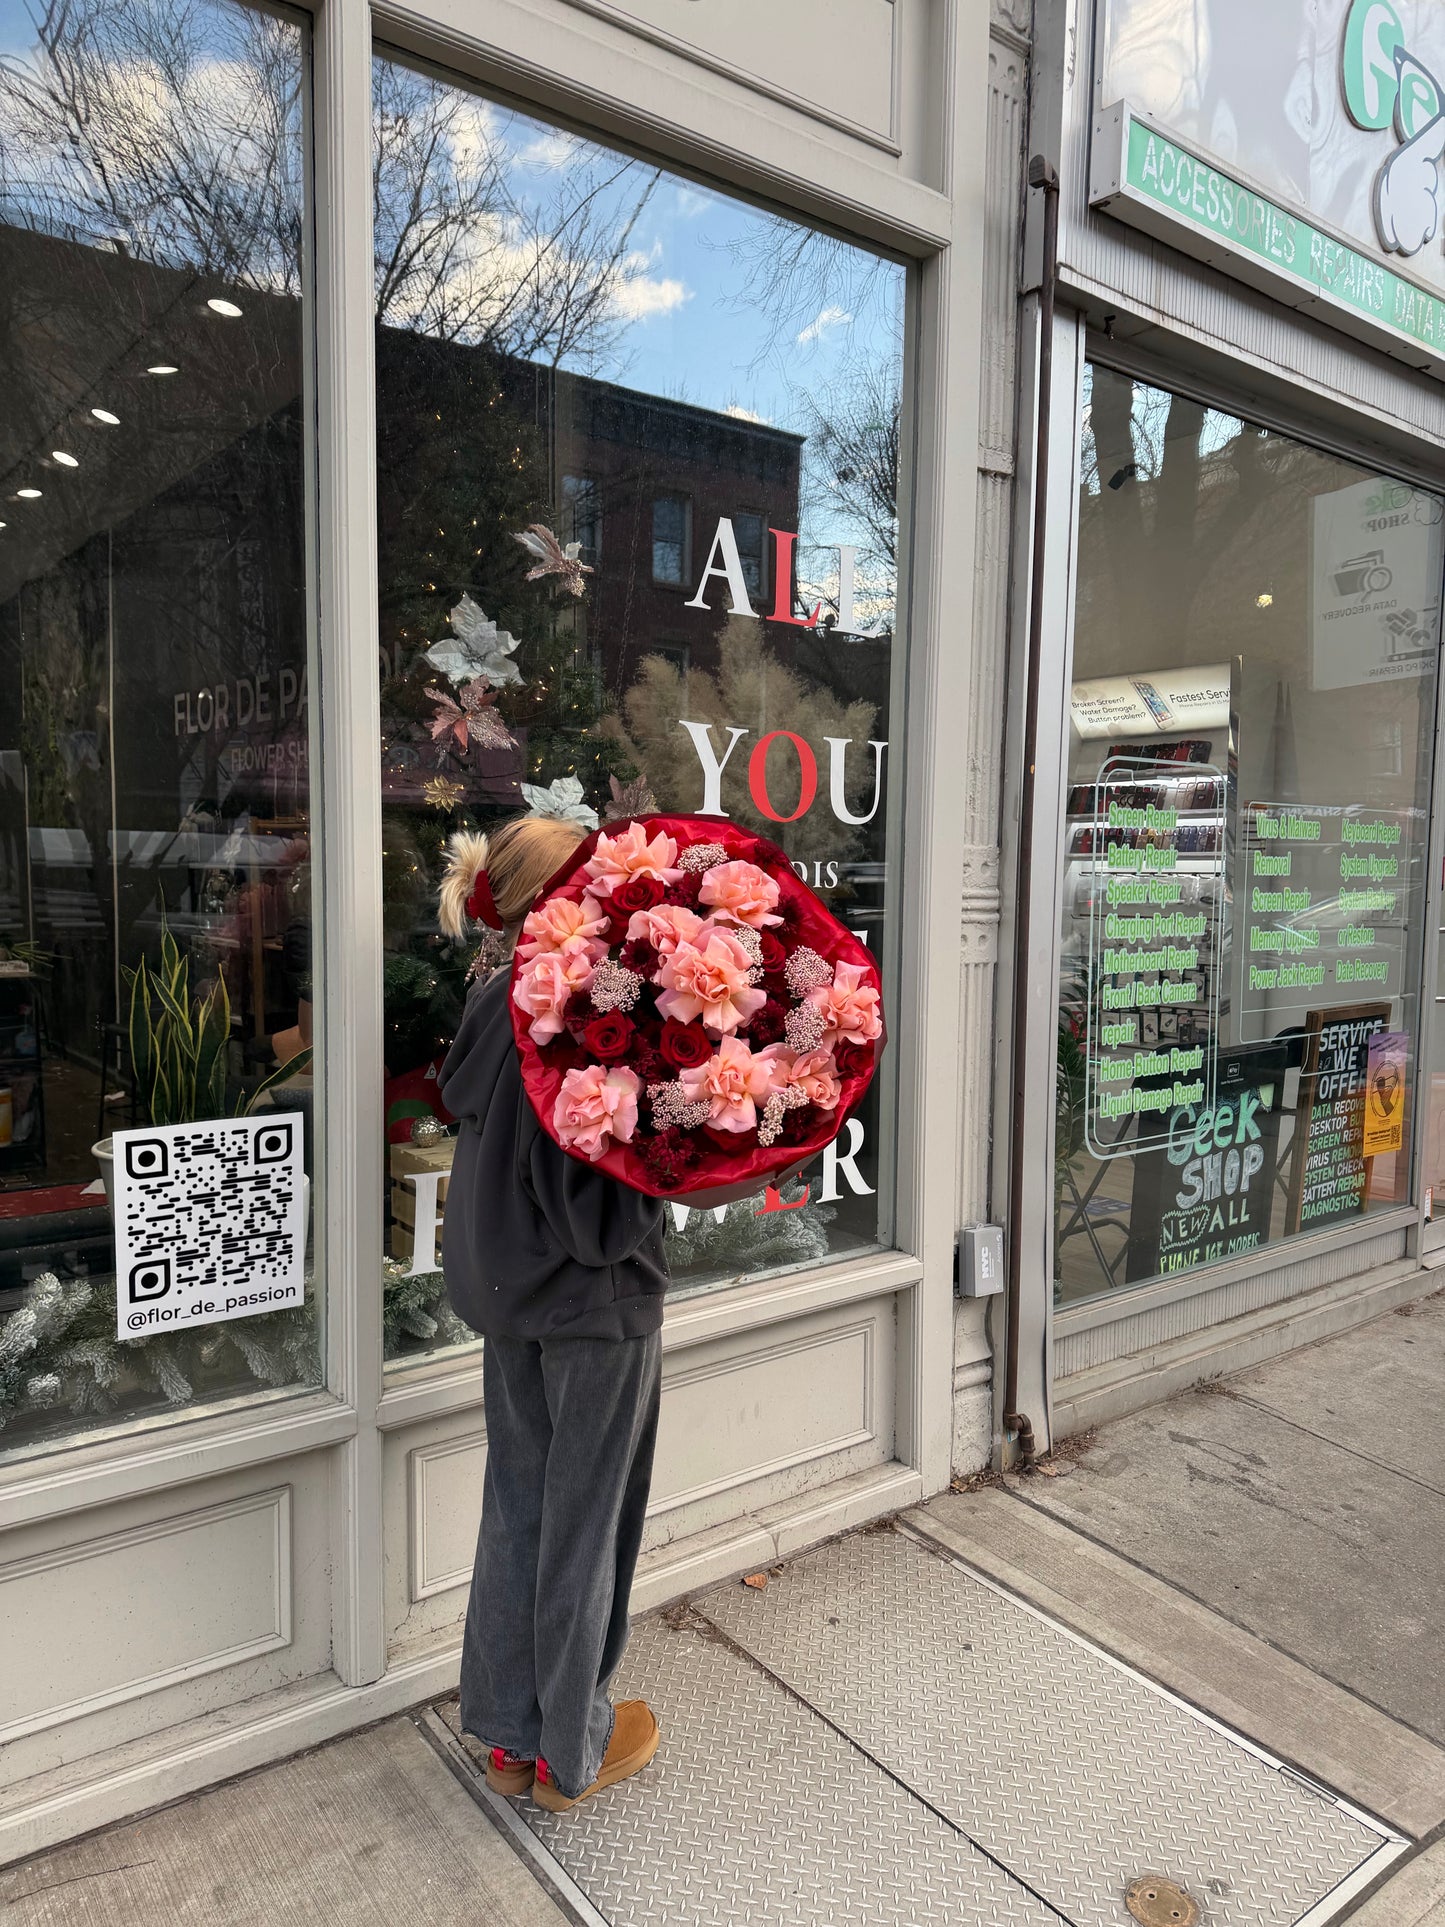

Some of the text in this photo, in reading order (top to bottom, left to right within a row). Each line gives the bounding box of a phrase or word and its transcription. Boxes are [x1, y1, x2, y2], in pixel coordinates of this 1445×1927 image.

[1142, 136, 1296, 264] ACCESSORIES
[1310, 232, 1384, 311] REPAIRS
[1394, 282, 1434, 340] DATA
[684, 516, 884, 639] ALL
[174, 684, 229, 736] FLOR
[237, 671, 272, 726] DE
[1072, 696, 1125, 709] Broken Screen?
[1080, 704, 1137, 716] Water Damage?
[1169, 692, 1206, 704] Fastest
[1088, 711, 1147, 724] Button problem?
[231, 742, 284, 772] FLOWER
[679, 720, 889, 826] YOU
[1109, 800, 1179, 833] Screen Repair
[1255, 813, 1321, 840] Virus & Malware
[1341, 818, 1401, 848] Keyboard Repair
[1108, 842, 1178, 875] Battery Repair
[1253, 850, 1292, 877] Removal
[1340, 852, 1398, 882] System Upgrade
[1106, 879, 1182, 909] Speaker Repair
[1252, 886, 1312, 916] Screen Repair
[1338, 887, 1366, 916] System
[1105, 912, 1207, 944] Charging Port Repair
[1250, 924, 1320, 956] Memory Upgrade
[1337, 923, 1375, 947] or Restore
[1104, 944, 1199, 975] Motherboard Repair
[1336, 958, 1390, 985] Date Recovery
[1249, 961, 1325, 991] Power Jack Repair
[1103, 982, 1130, 1010] Front
[1136, 980, 1161, 1007] Back
[1161, 979, 1197, 1004] Camera
[1101, 1018, 1136, 1050] repair
[1319, 1020, 1383, 1052] SERVICE
[1100, 1045, 1204, 1082] Home Button Repair
[1334, 1046, 1359, 1072] WE
[1100, 1078, 1205, 1121] Liquid Damage Repair
[1311, 1102, 1332, 1121] DATA
[1309, 1115, 1348, 1137] DESKTOP
[1308, 1131, 1341, 1154] SCREEN
[1304, 1158, 1364, 1186] SYSTEM CHECK
[1305, 1151, 1330, 1171] VIRUS
[1176, 1144, 1264, 1209] SHOP
[1302, 1172, 1366, 1204] BATTERY REPAIR
[1301, 1191, 1360, 1221] DIAGNOSTICS
[1162, 1198, 1250, 1245] NEW ALL
[127, 1286, 296, 1330] @flor_de_passion
